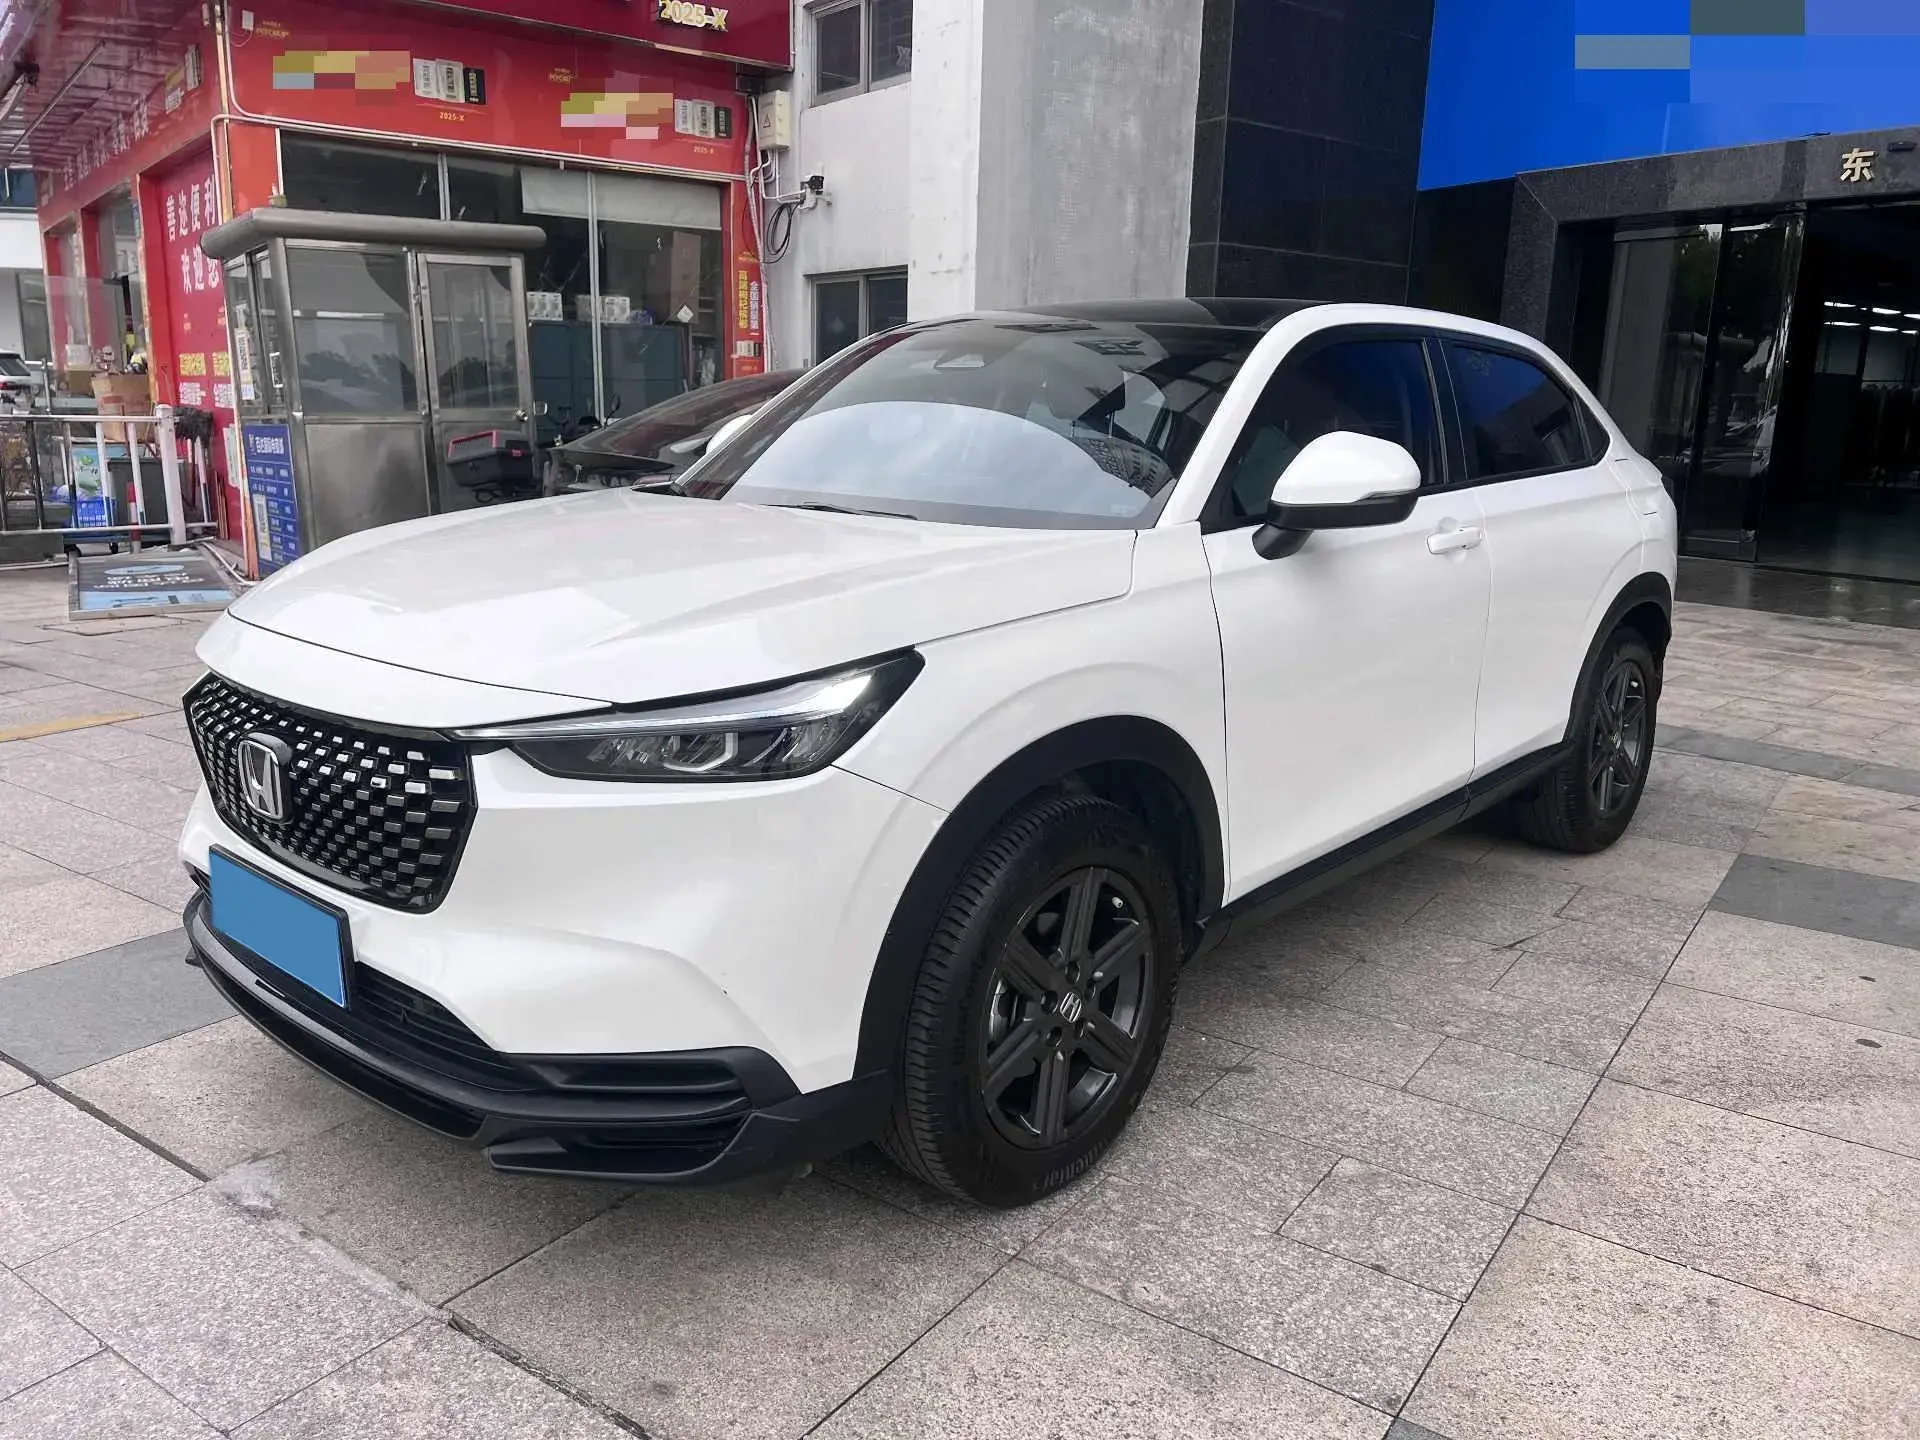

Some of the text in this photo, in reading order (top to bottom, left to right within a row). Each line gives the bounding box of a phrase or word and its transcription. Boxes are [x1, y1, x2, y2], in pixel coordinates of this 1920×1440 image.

[659, 0, 729, 30] 2025-X
[439, 111, 465, 121] 2025-X
[1840, 148, 1875, 181] 东
